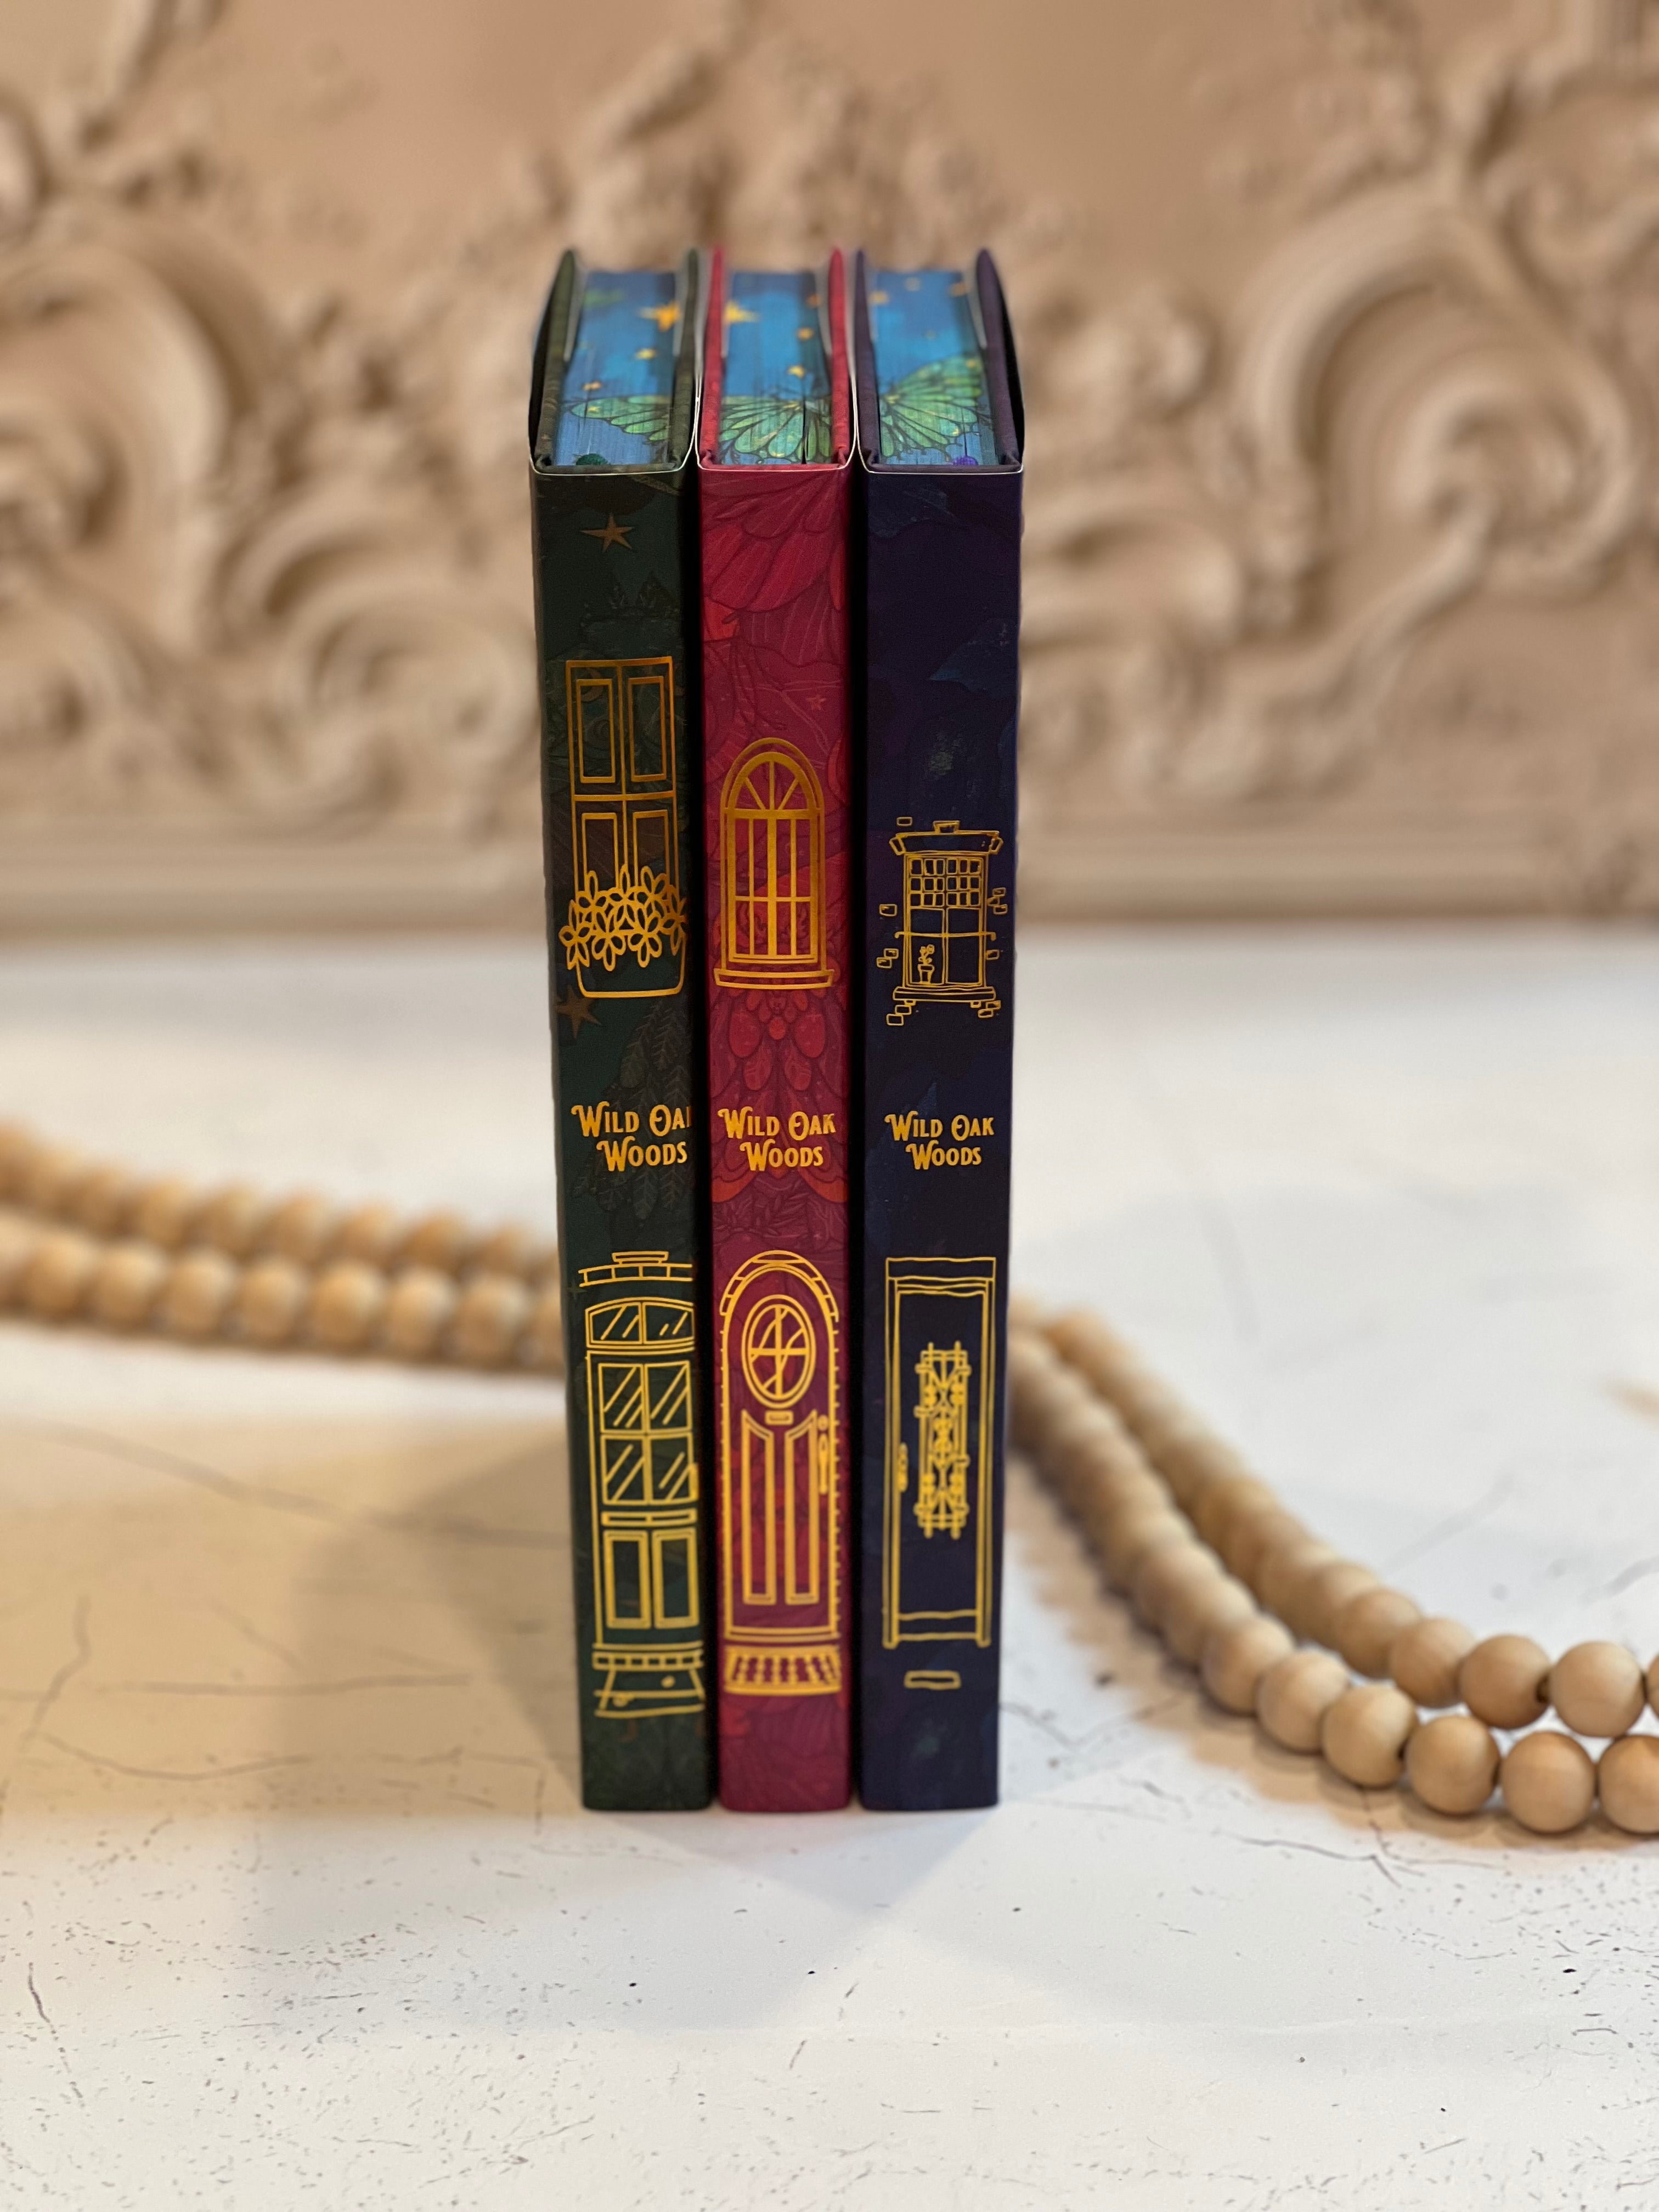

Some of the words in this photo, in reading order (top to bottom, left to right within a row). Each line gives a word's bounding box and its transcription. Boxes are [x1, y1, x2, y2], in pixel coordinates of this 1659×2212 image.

[571, 1101, 640, 1137] WILD
[717, 1106, 780, 1139] WILD
[788, 1111, 836, 1141] OAK
[884, 1110, 943, 1141] WILD
[951, 1114, 995, 1141] OAK
[596, 1136, 687, 1172] WOODS
[739, 1138, 823, 1171] WOODS
[905, 1139, 982, 1170] WOODS
